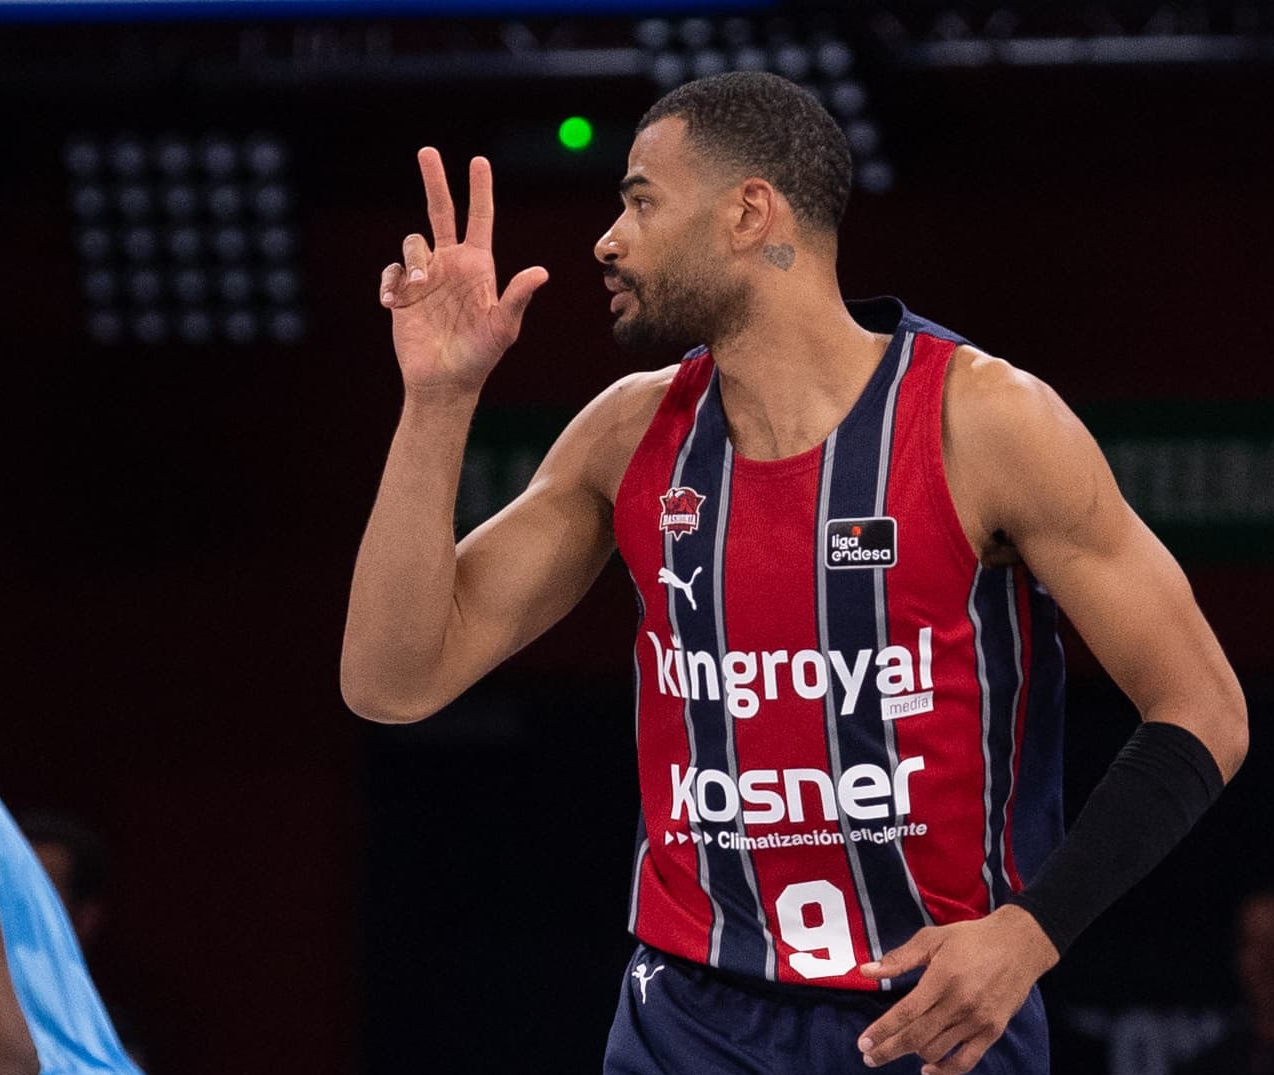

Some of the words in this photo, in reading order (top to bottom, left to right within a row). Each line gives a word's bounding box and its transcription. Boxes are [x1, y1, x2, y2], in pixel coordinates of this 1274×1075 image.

[831, 534, 858, 550] liga
[831, 547, 891, 562] endesa
[646, 627, 933, 718] kingroyal
[717, 829, 845, 851] Climatización
[775, 880, 857, 980] 9
